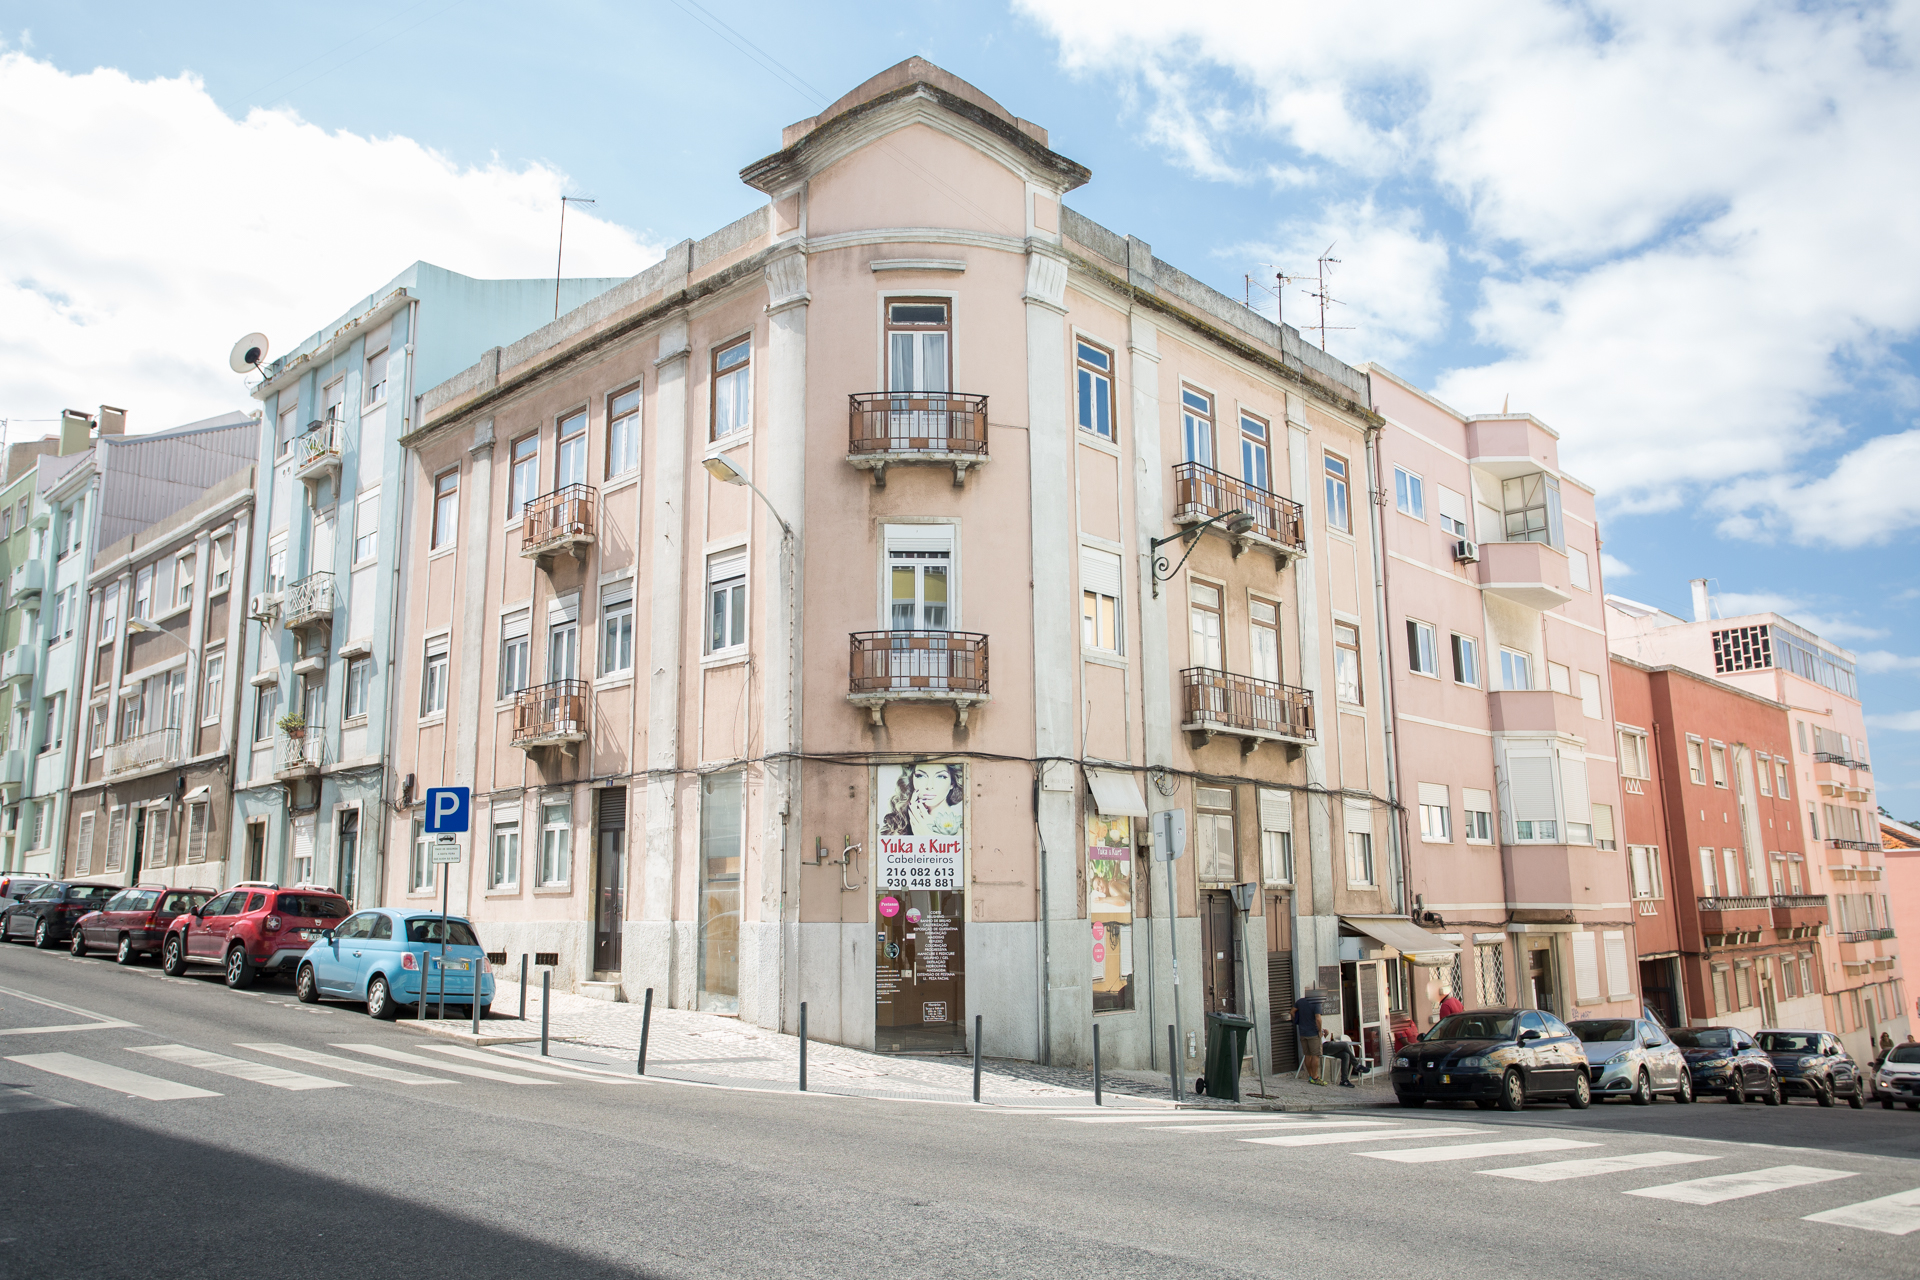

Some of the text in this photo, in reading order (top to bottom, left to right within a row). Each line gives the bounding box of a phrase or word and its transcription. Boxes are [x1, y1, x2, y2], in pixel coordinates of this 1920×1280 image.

[434, 791, 460, 829] P
[881, 838, 961, 854] Yuka & Kurt
[1097, 847, 1107, 855] Yuka
[1111, 847, 1122, 855] Kurt
[887, 854, 953, 864] Cabeleireiros
[886, 867, 954, 877] 216 082 613
[887, 878, 954, 887] 930 448 881
